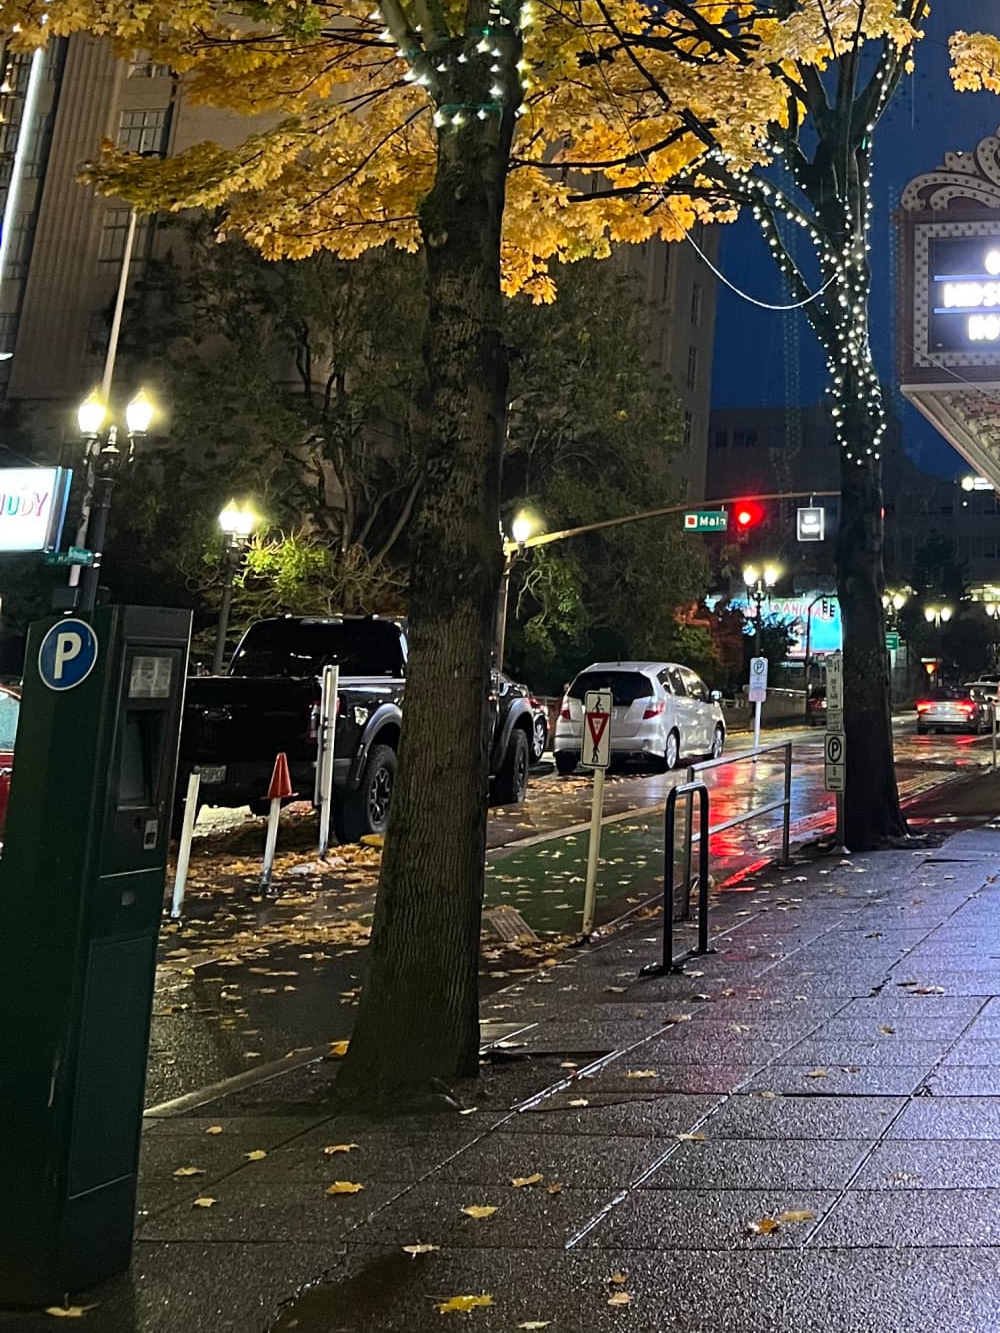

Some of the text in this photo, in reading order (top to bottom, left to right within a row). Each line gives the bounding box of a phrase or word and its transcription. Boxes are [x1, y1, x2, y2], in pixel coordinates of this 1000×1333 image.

[700, 516, 726, 526] Main
[54, 632, 82, 680] P
[831, 741, 839, 757] P
